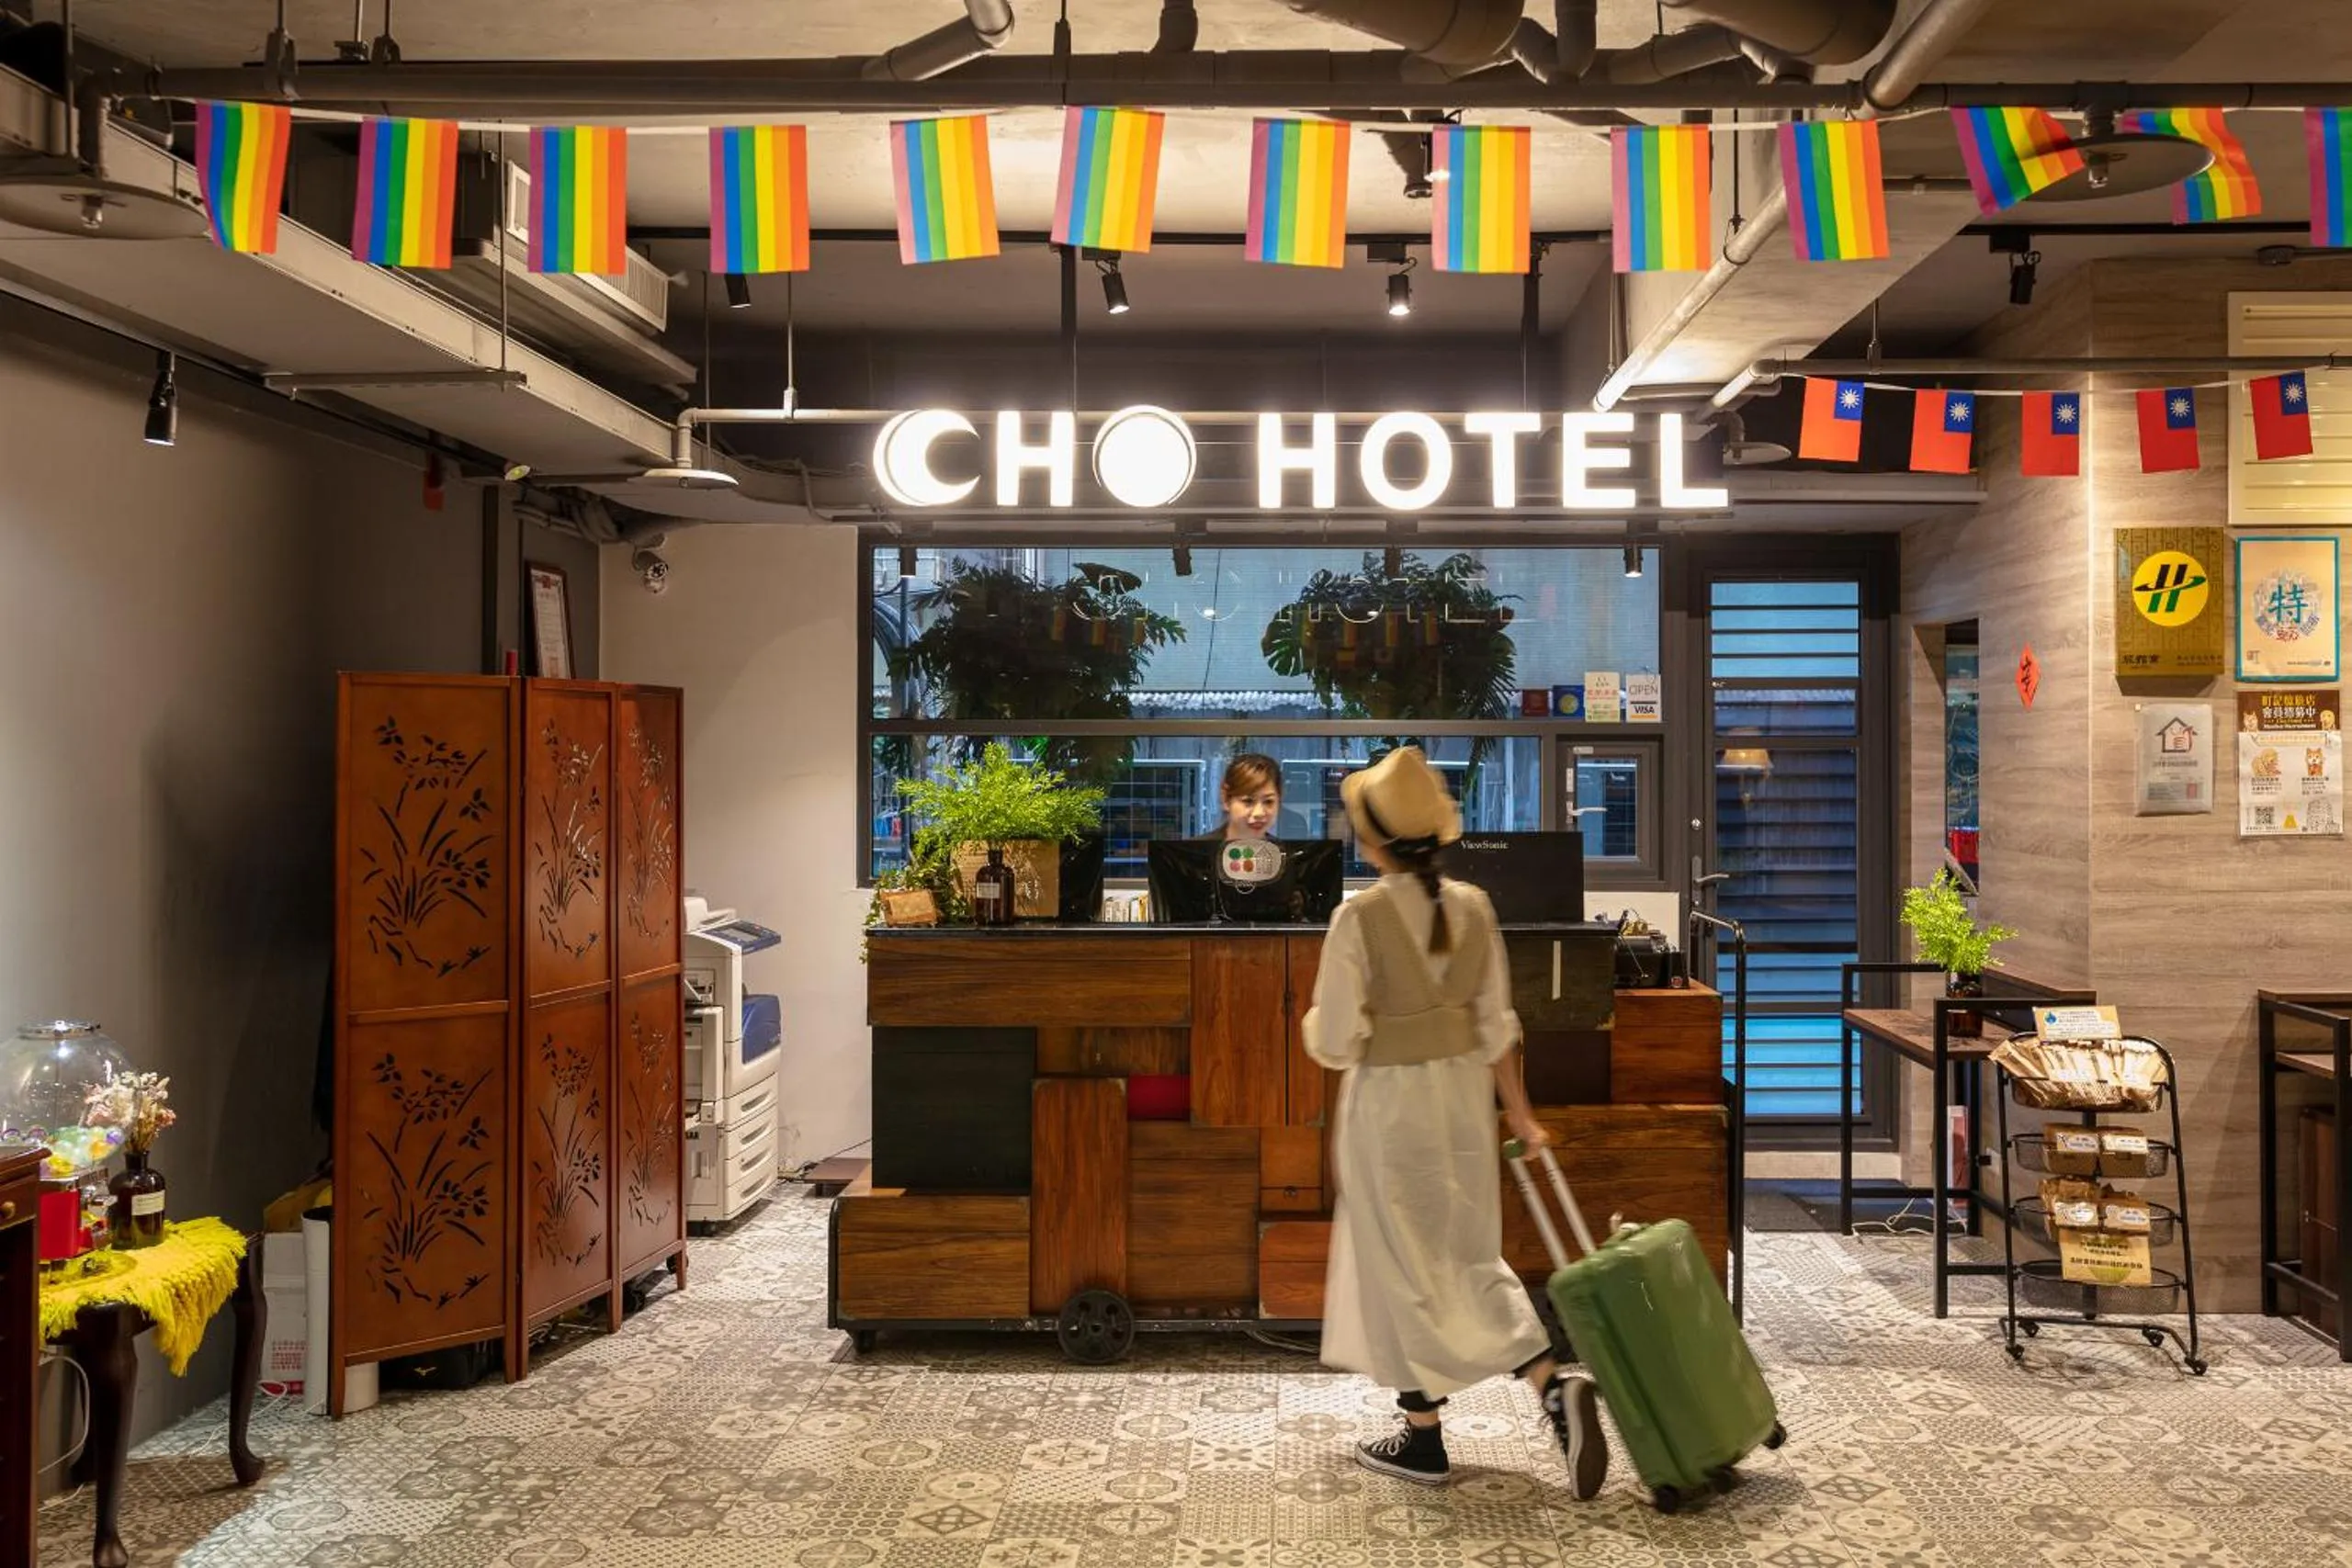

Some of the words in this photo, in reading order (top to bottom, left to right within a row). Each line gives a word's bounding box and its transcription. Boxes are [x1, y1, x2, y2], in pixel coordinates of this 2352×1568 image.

[1258, 412, 1729, 510] HOTEL
[2267, 583, 2308, 624] 特
[1629, 684, 1658, 695] OPEN
[1634, 705, 1655, 714] VISA
[1460, 840, 1510, 850] ViewSonic
